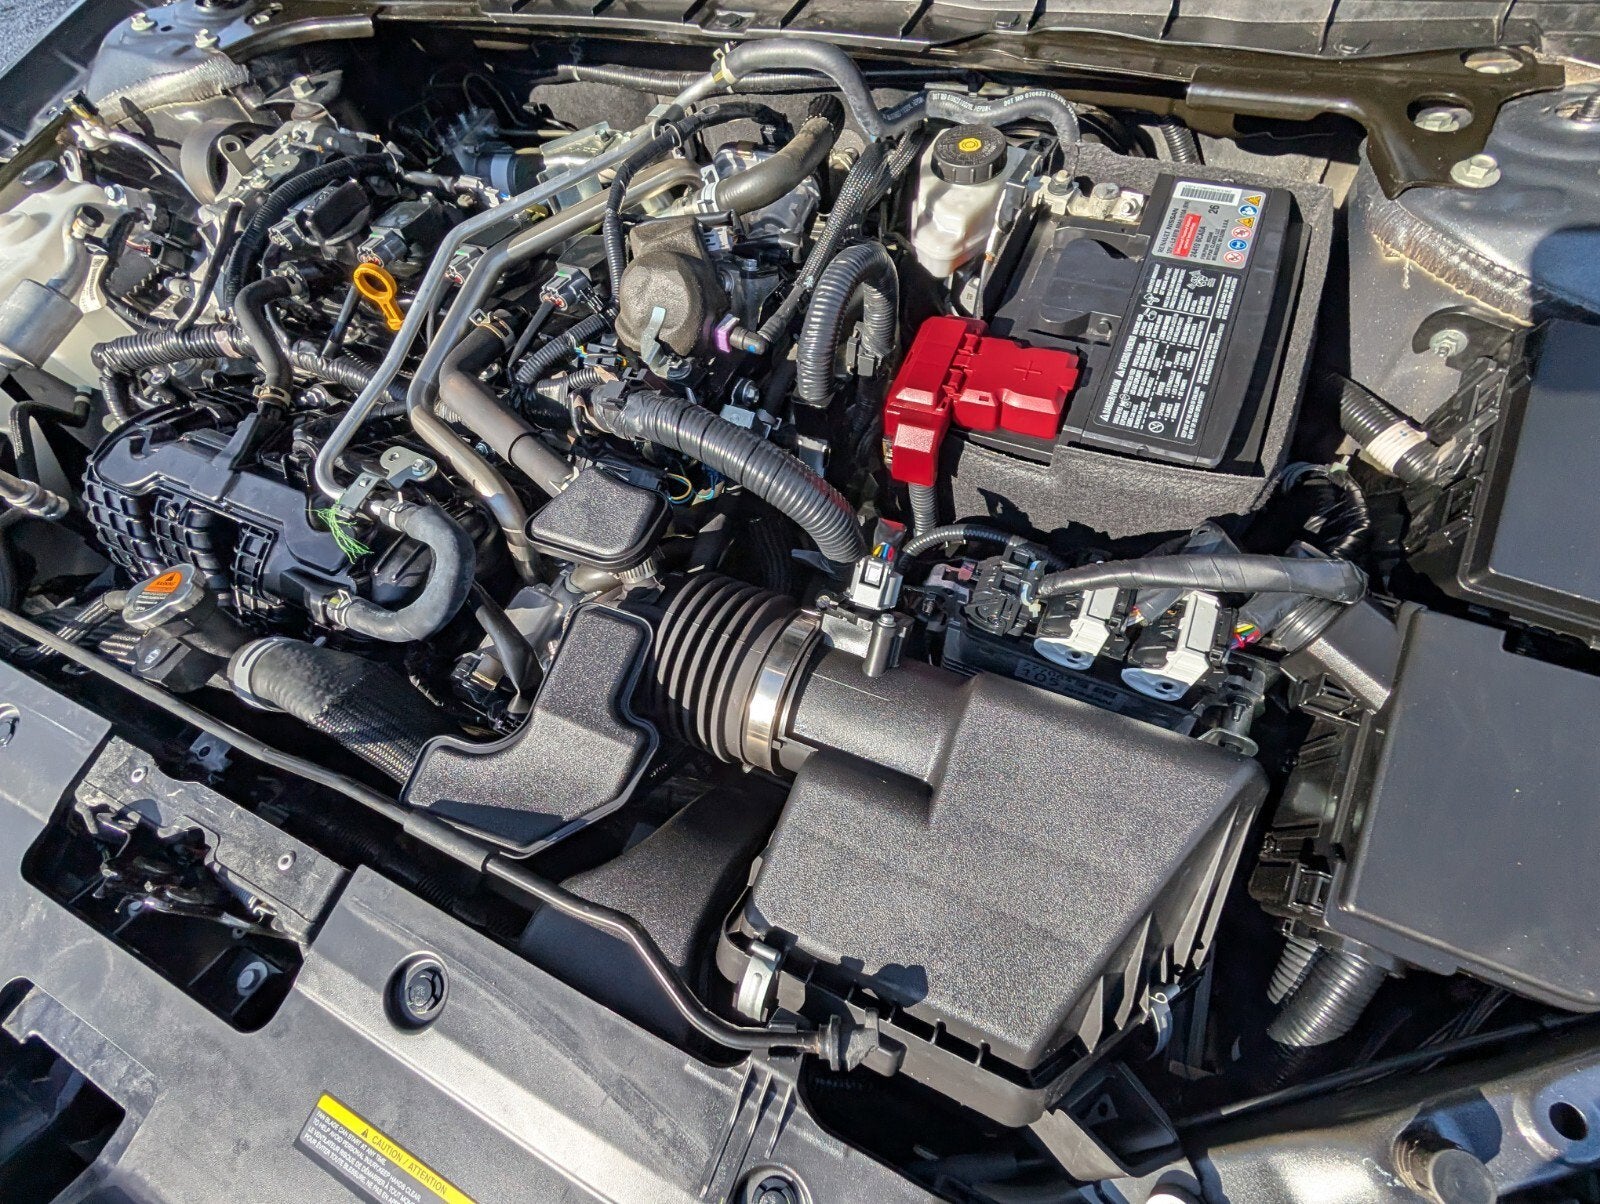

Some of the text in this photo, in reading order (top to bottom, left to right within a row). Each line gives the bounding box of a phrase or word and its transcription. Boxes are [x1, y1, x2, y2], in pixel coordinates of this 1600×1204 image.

[1158, 207, 1179, 253] RENAULT NISSAN
[1207, 204, 1220, 214] 26
[371, 1136, 403, 1162] CAUTION
[408, 1163, 447, 1194] ATTENTION
